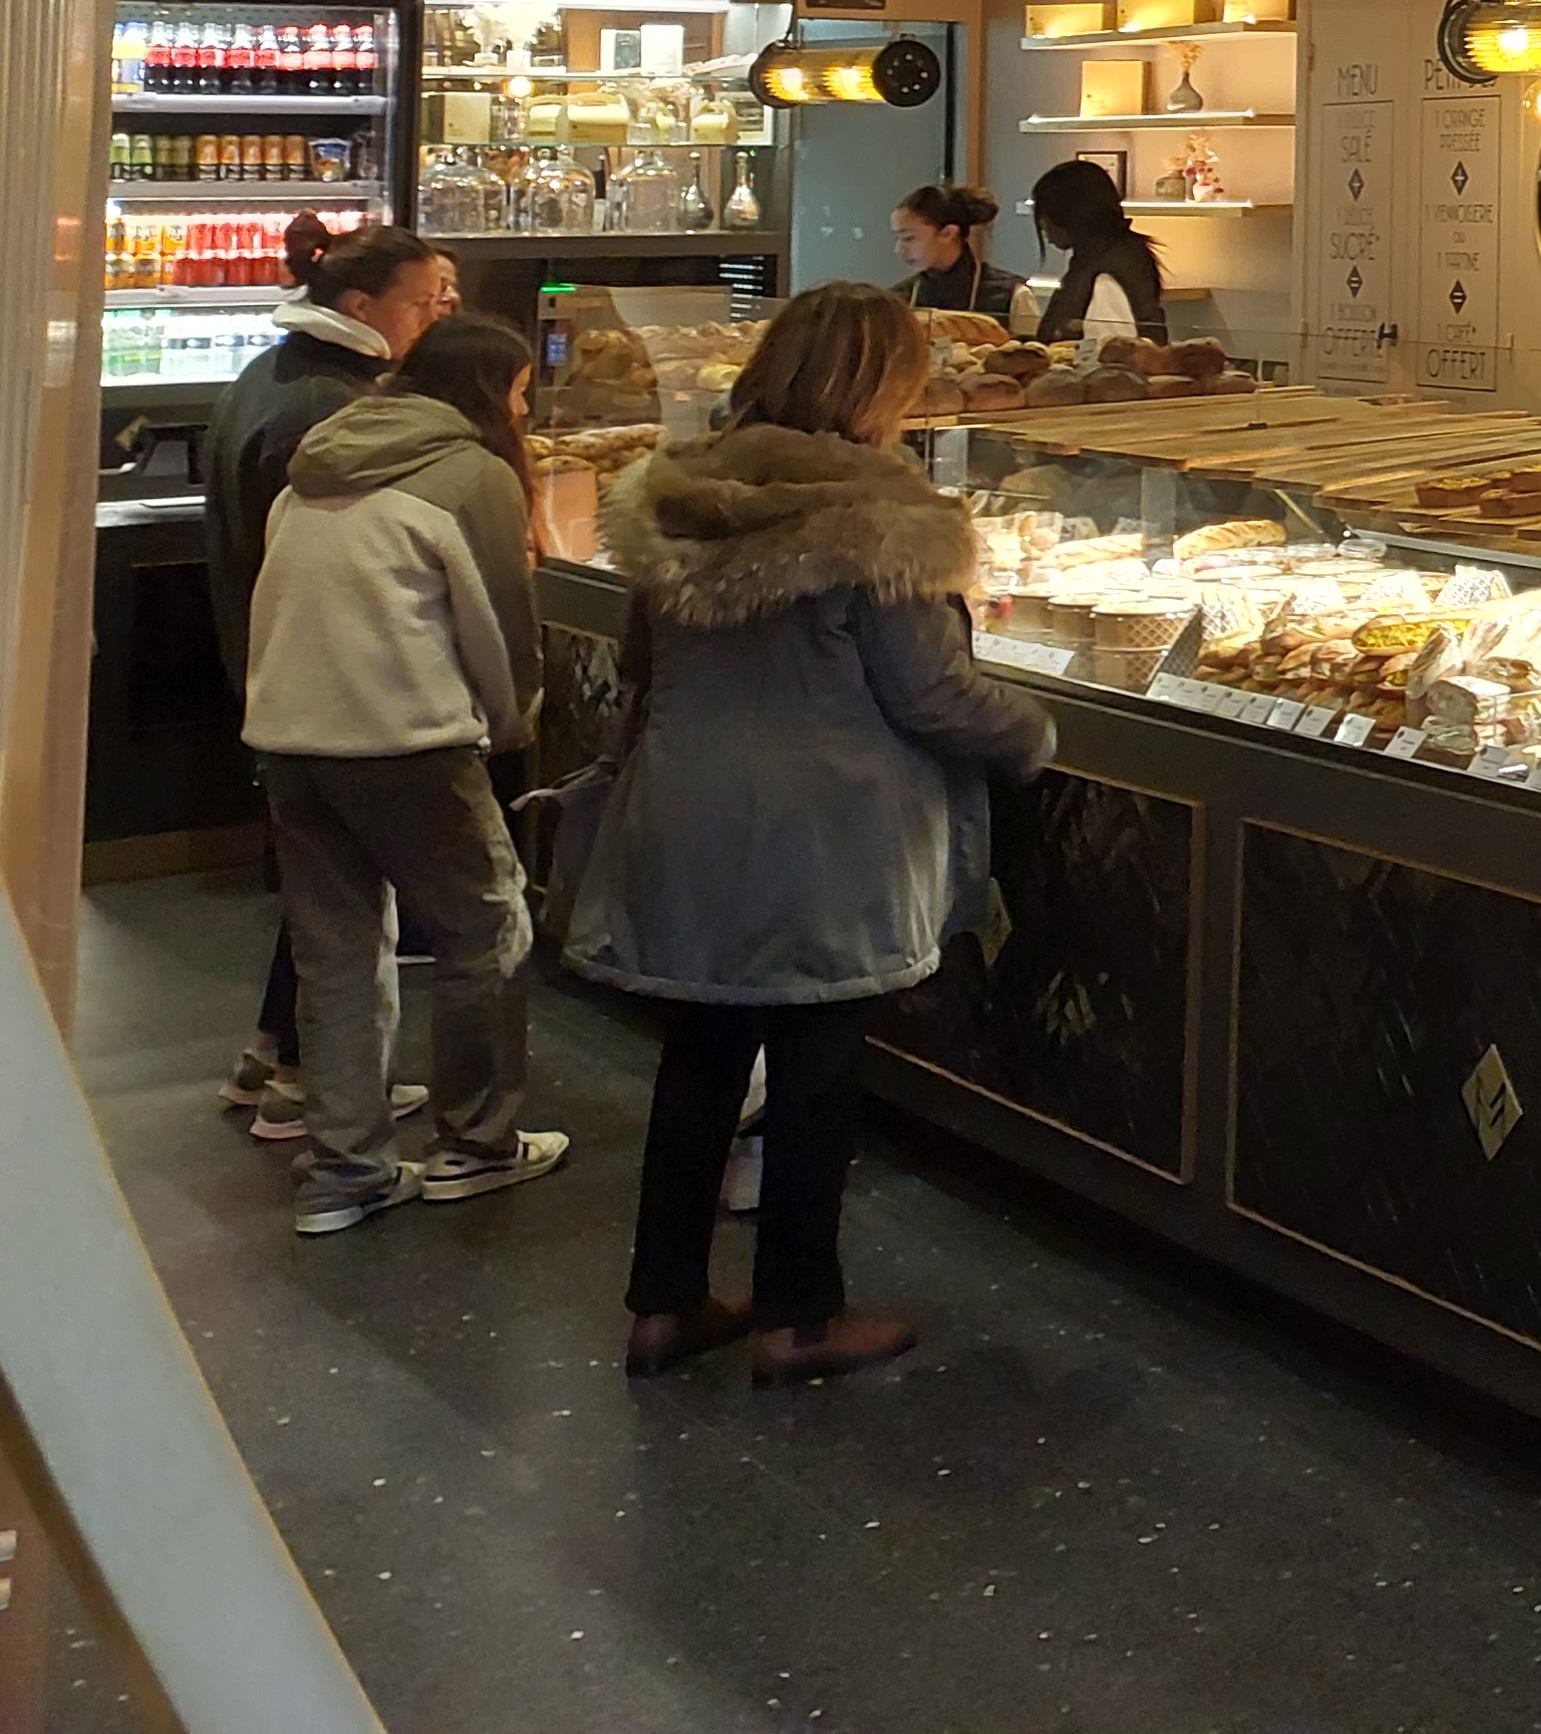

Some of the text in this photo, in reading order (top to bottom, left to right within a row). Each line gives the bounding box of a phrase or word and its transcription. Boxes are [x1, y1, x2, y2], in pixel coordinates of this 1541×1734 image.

[1337, 63, 1379, 97] MENU
[1443, 108, 1486, 129] ORANGE
[1341, 128, 1373, 164] SALÉ
[1440, 128, 1481, 152] PRESSÉE
[1426, 348, 1486, 381] OFFERT
